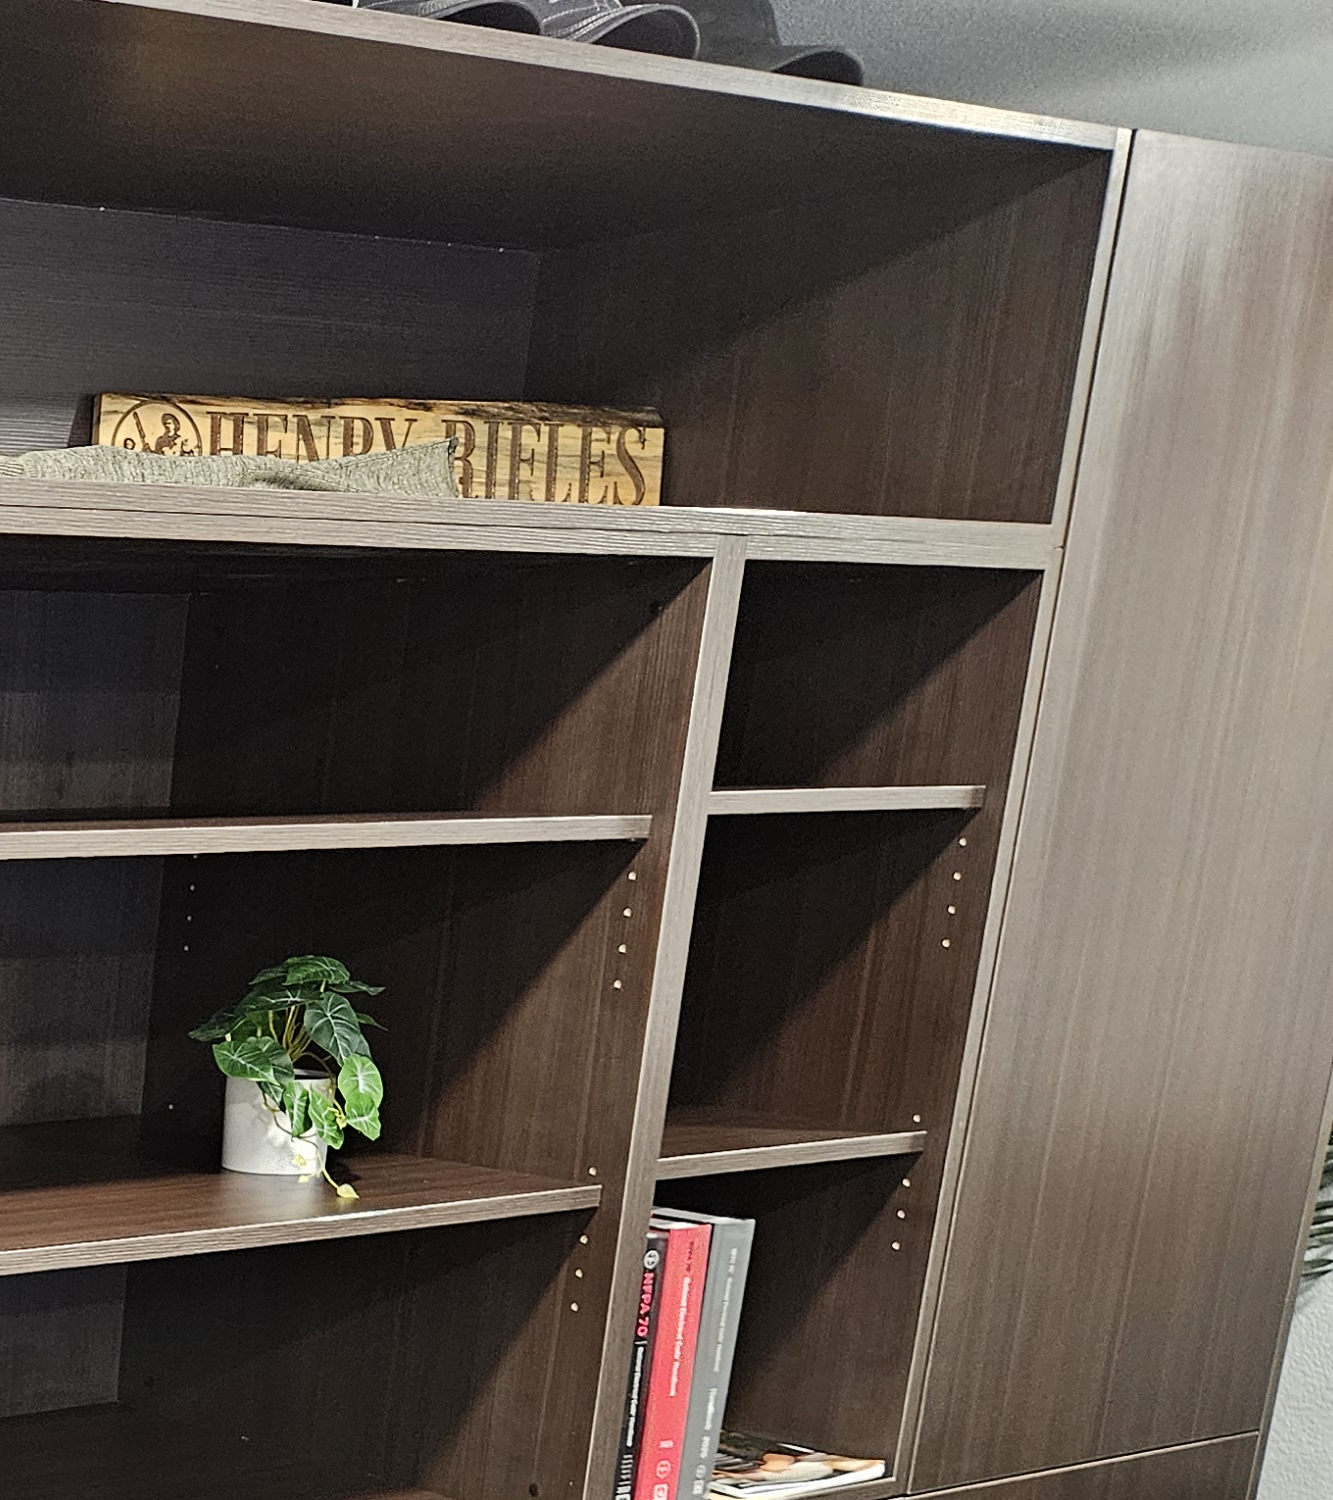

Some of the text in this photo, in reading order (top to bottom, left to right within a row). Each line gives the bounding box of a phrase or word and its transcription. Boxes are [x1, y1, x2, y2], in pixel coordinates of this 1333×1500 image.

[441, 418, 650, 506] RIFLES
[636, 1272, 655, 1337] NFPA 70
